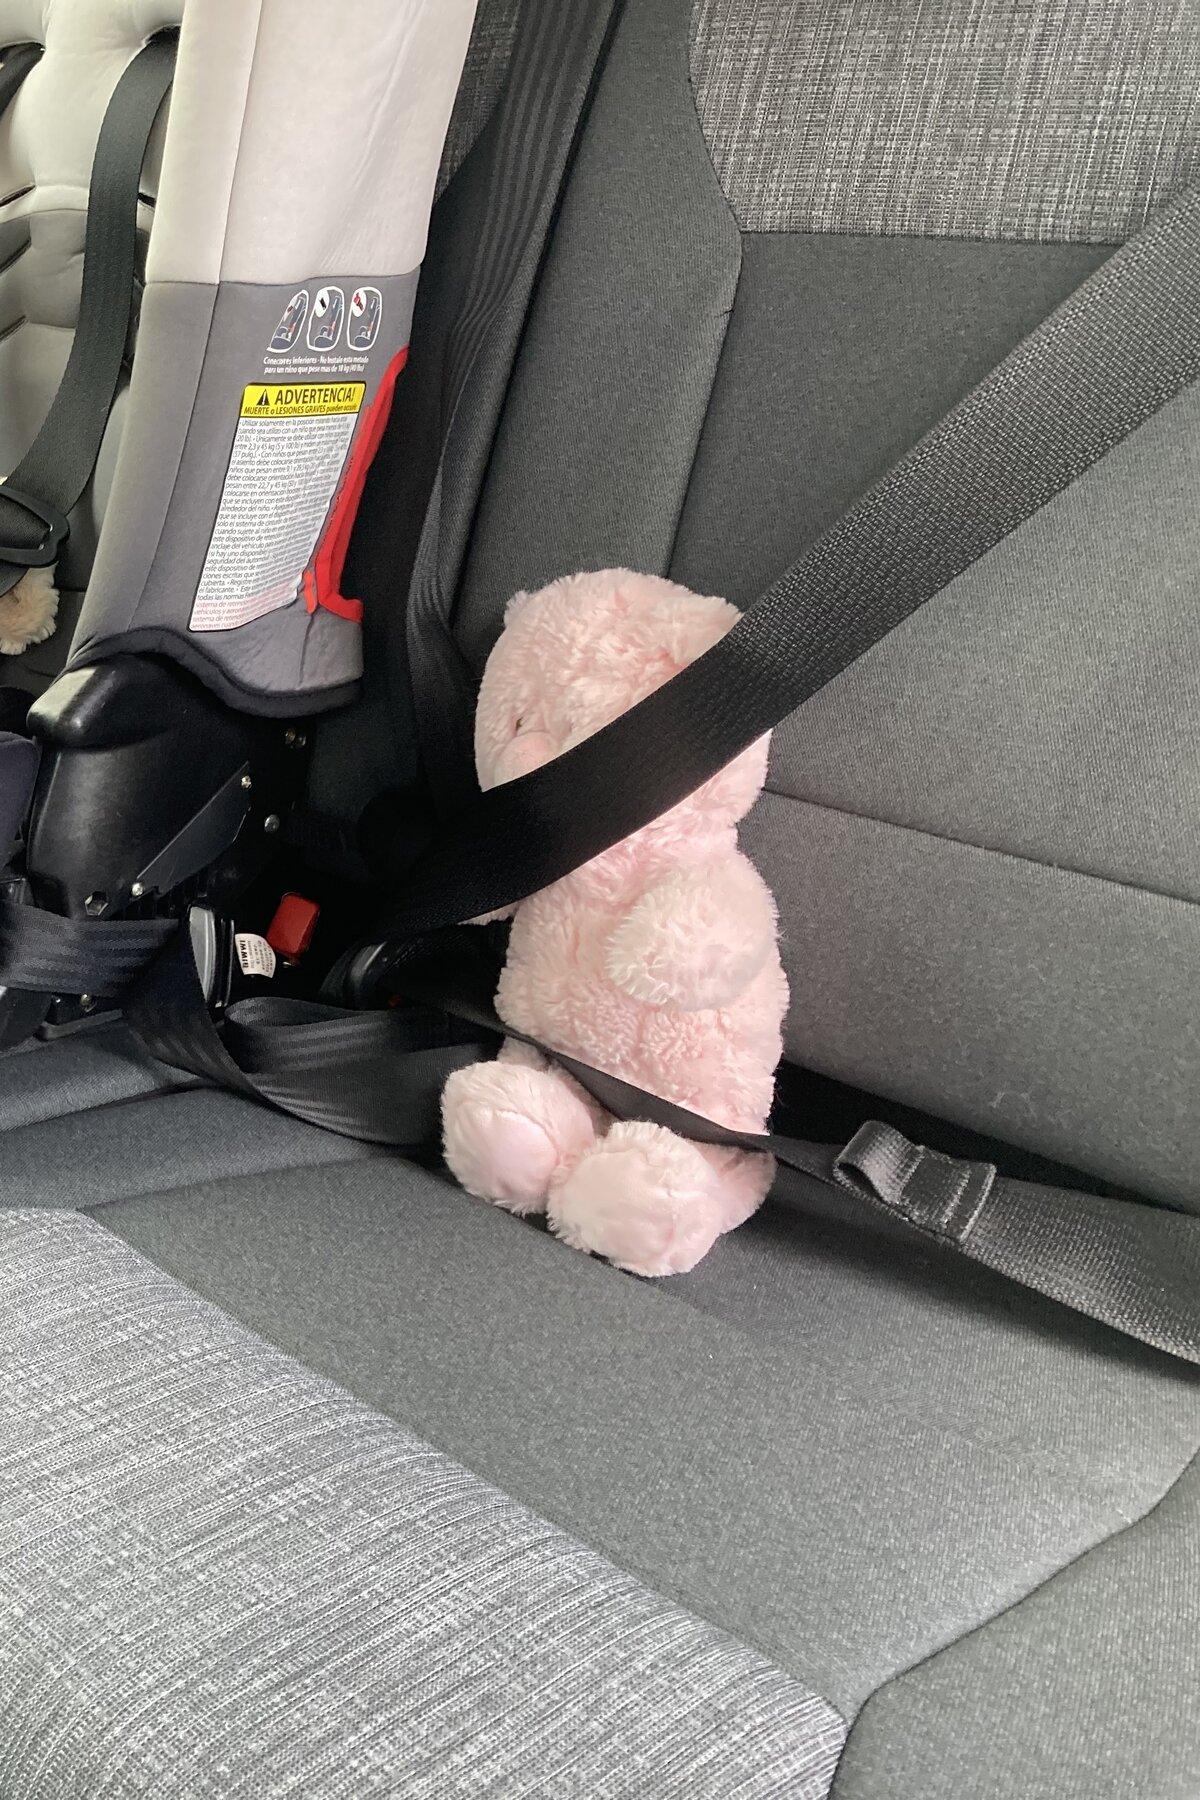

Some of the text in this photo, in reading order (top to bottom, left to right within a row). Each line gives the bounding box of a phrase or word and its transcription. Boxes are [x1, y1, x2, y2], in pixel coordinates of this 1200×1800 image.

[274, 387, 356, 405] ADVERTENCIA!
[244, 406, 269, 414] MUERTE
[275, 406, 304, 415] LESIONES
[305, 405, 326, 414] GRAVES
